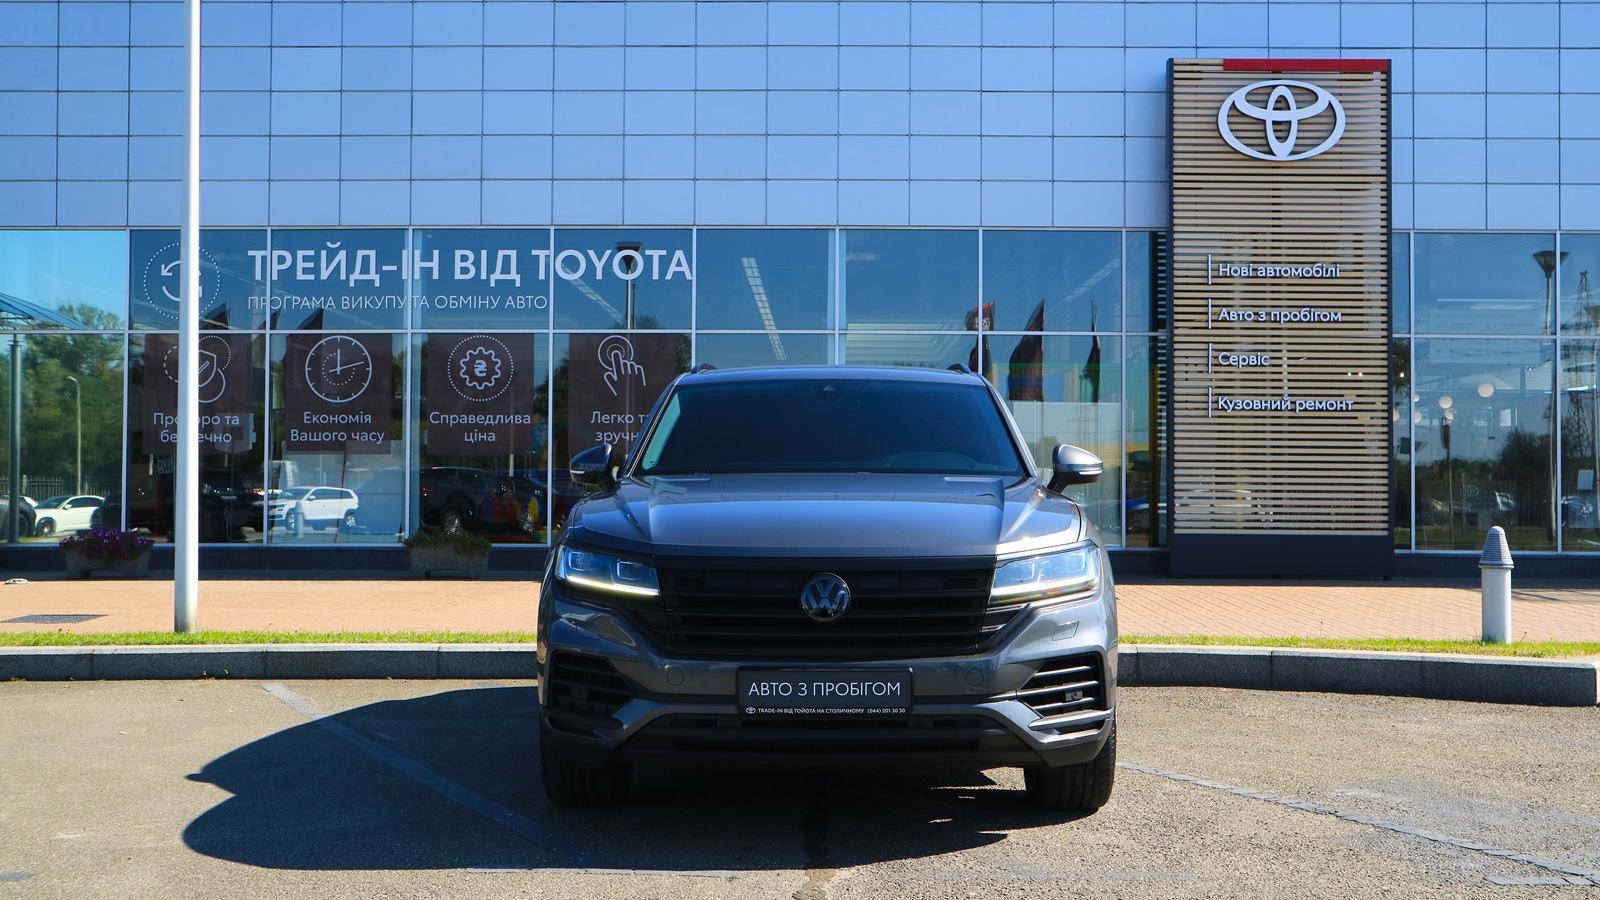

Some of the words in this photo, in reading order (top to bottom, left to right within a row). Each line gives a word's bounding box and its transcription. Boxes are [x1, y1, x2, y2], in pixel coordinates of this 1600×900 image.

[248, 241, 439, 287] ТРЕЙД-ІН
[454, 249, 520, 287] ВІД
[532, 249, 693, 280] TOYOTA
[1218, 263, 1253, 277] Нові
[1257, 263, 1340, 277] автомобілі
[248, 296, 336, 310] ПРОГРАМА
[341, 295, 407, 309] ВИКУПУ
[411, 295, 430, 309] ТА
[434, 295, 501, 309] ОБМІНУ
[504, 295, 548, 309] АВТО
[1218, 307, 1254, 321] Авто
[1258, 310, 1266, 321] з
[1270, 308, 1342, 324] пробігом
[1218, 352, 1270, 368] Сервіс
[1218, 396, 1291, 412] Кузовний
[1295, 400, 1354, 413] ремонт
[224, 415, 240, 425] та
[303, 411, 372, 424] Економія
[429, 411, 531, 426] Справедлива
[590, 411, 634, 424] Легко
[160, 429, 232, 443] беечно
[290, 429, 348, 442] Вашого
[351, 432, 385, 445] часу
[464, 429, 496, 444] ціна
[595, 431, 640, 444] зручн
[749, 682, 793, 696] АВТО
[813, 682, 901, 696] ПРОБІГОМ
[784, 707, 794, 715] ВІД
[867, 707, 881, 715] (044)
